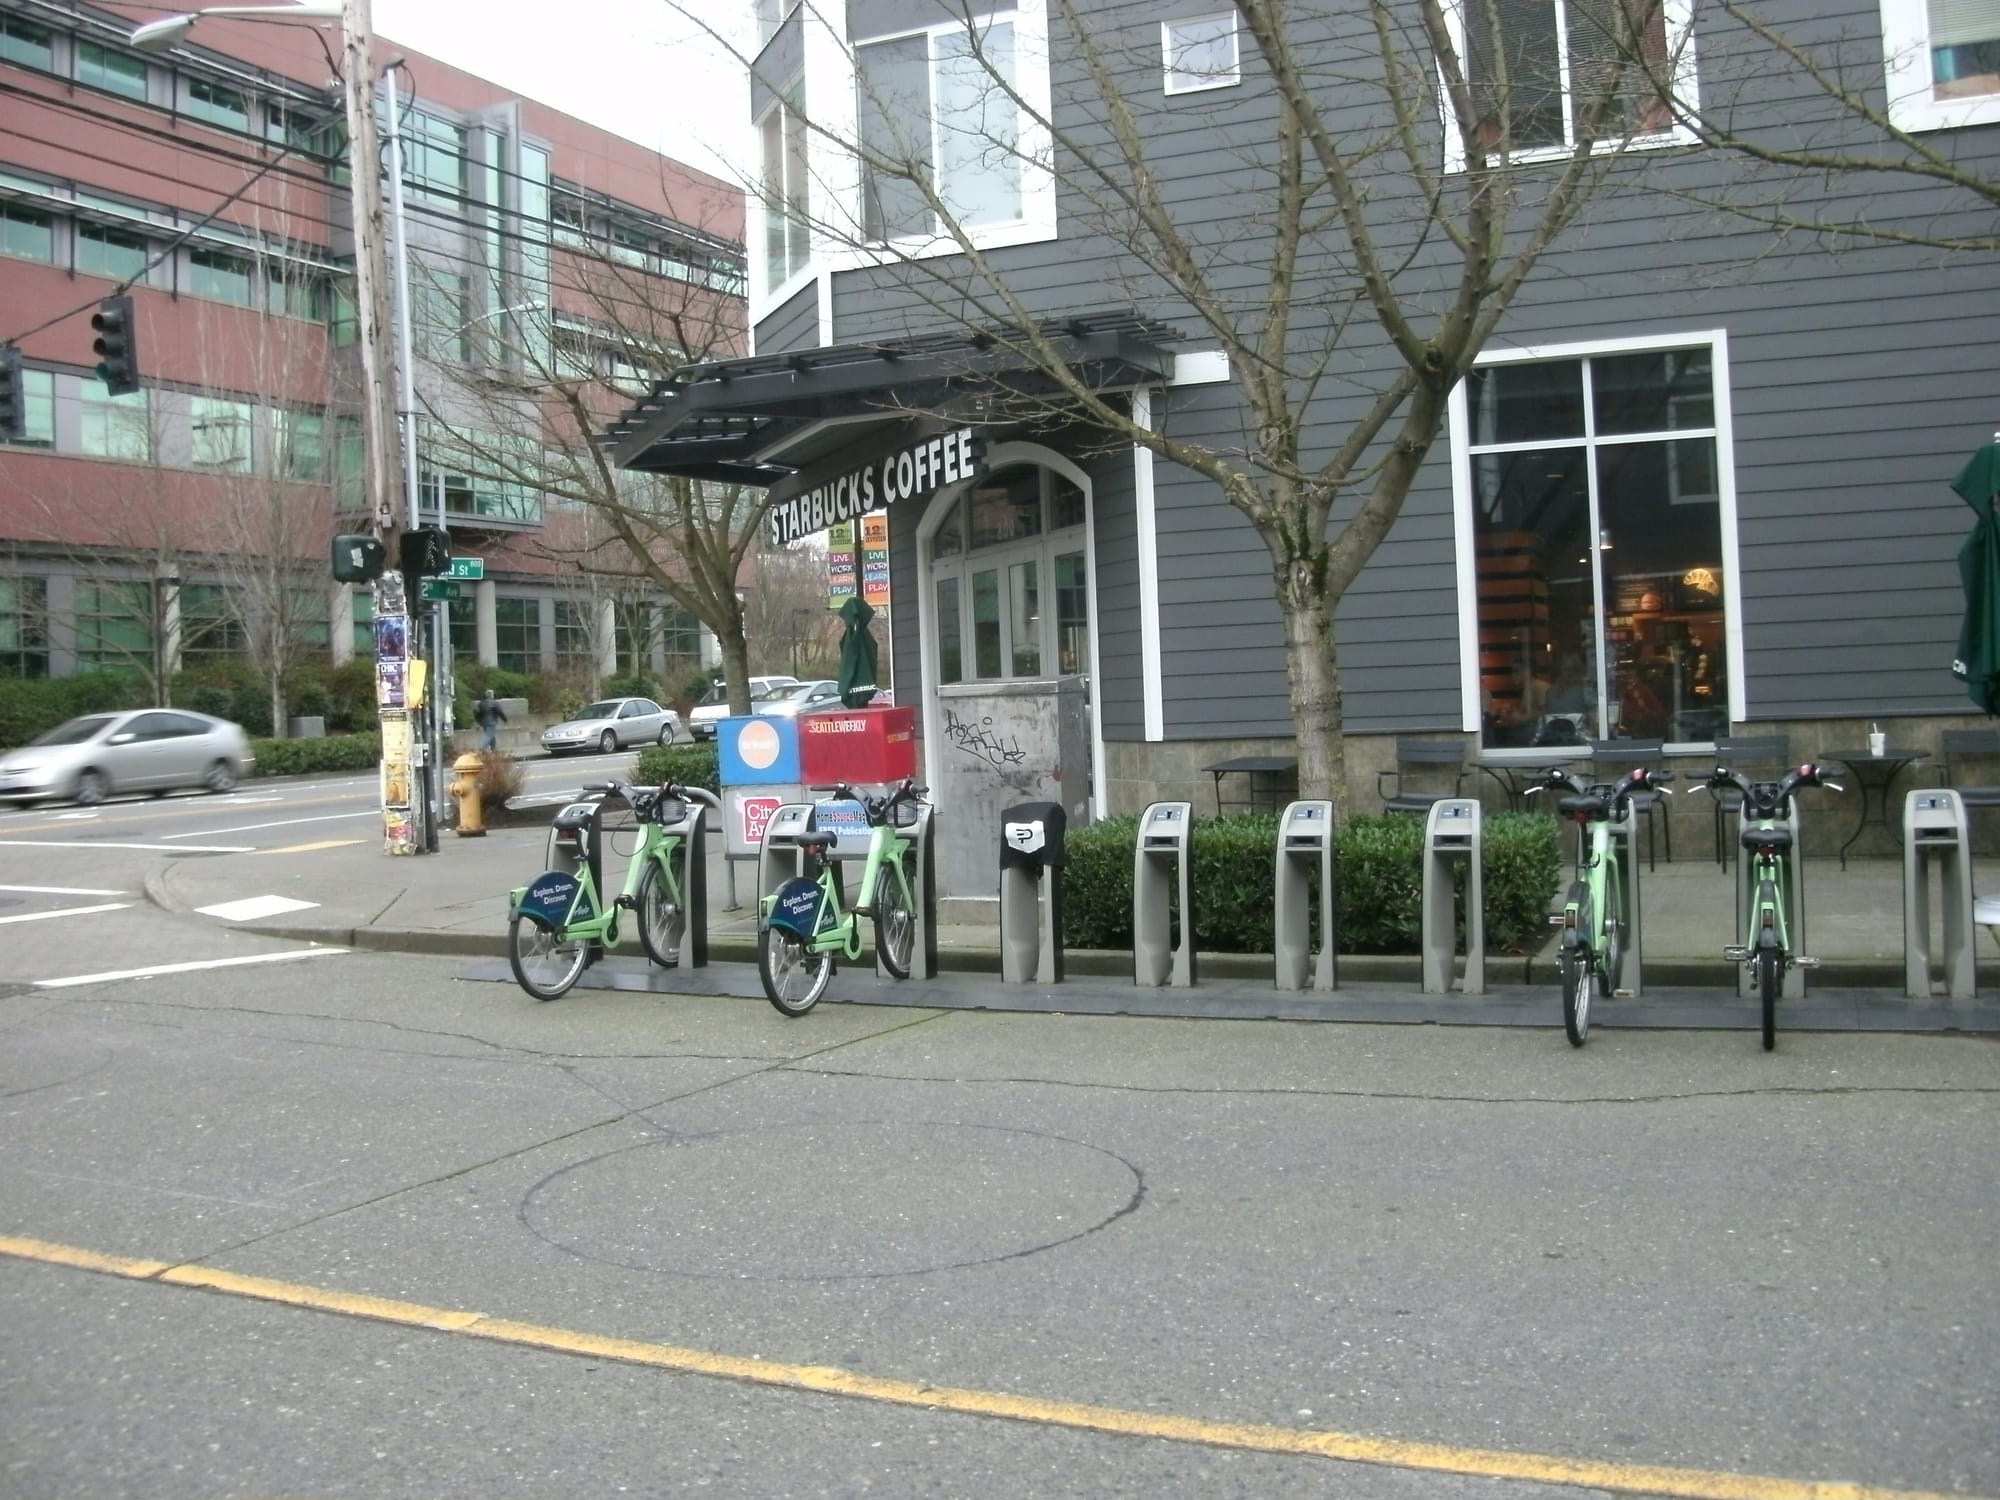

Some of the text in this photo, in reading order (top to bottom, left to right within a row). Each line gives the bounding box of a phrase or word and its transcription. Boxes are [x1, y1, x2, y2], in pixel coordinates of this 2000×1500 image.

[771, 427, 975, 545] STARBUCKS COFFEE
[833, 554, 849, 562] LIVE
[869, 551, 885, 559] LIVE
[459, 565, 469, 576] St
[831, 564, 853, 573] WORK
[833, 586, 852, 595] PLAY
[868, 583, 888, 592] PLAY
